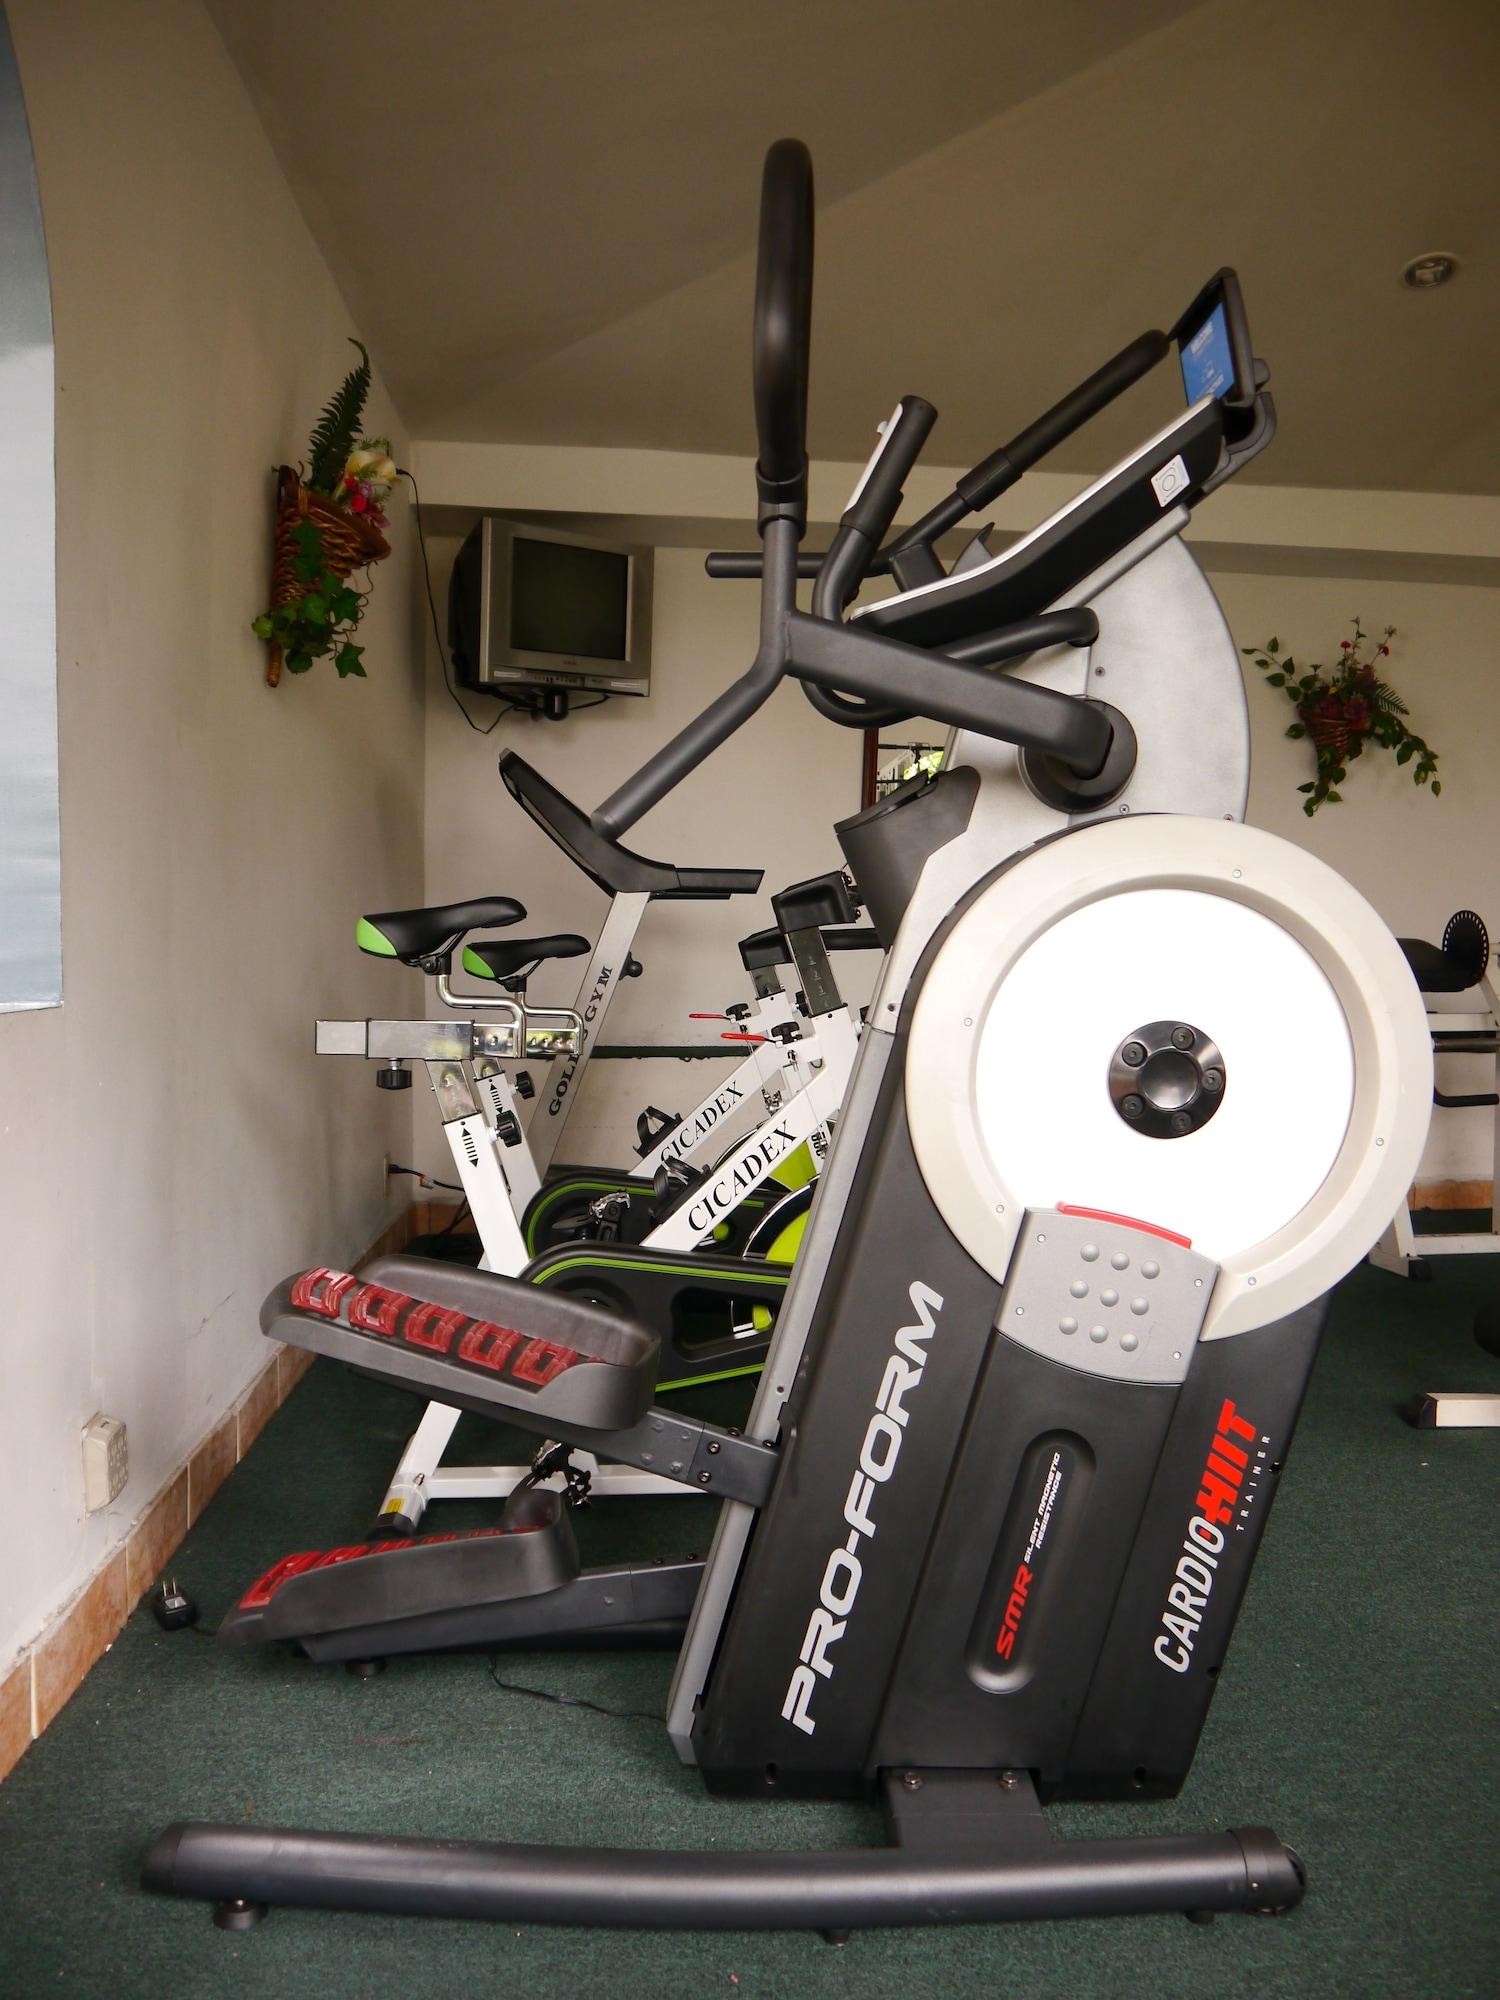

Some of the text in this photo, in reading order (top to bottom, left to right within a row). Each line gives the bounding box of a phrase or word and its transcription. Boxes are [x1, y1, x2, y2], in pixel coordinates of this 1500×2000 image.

[585, 966, 613, 1022] GYM
[688, 1119, 797, 1231] CICADEX
[781, 1280, 944, 1735] PRO-FORM
[1024, 1452, 1060, 1563] SILENT MAGNETIC
[1035, 1470, 1062, 1549] RESISTANCE
[1235, 1435, 1271, 1532] TRAINER
[996, 1563, 1033, 1660] SMR
